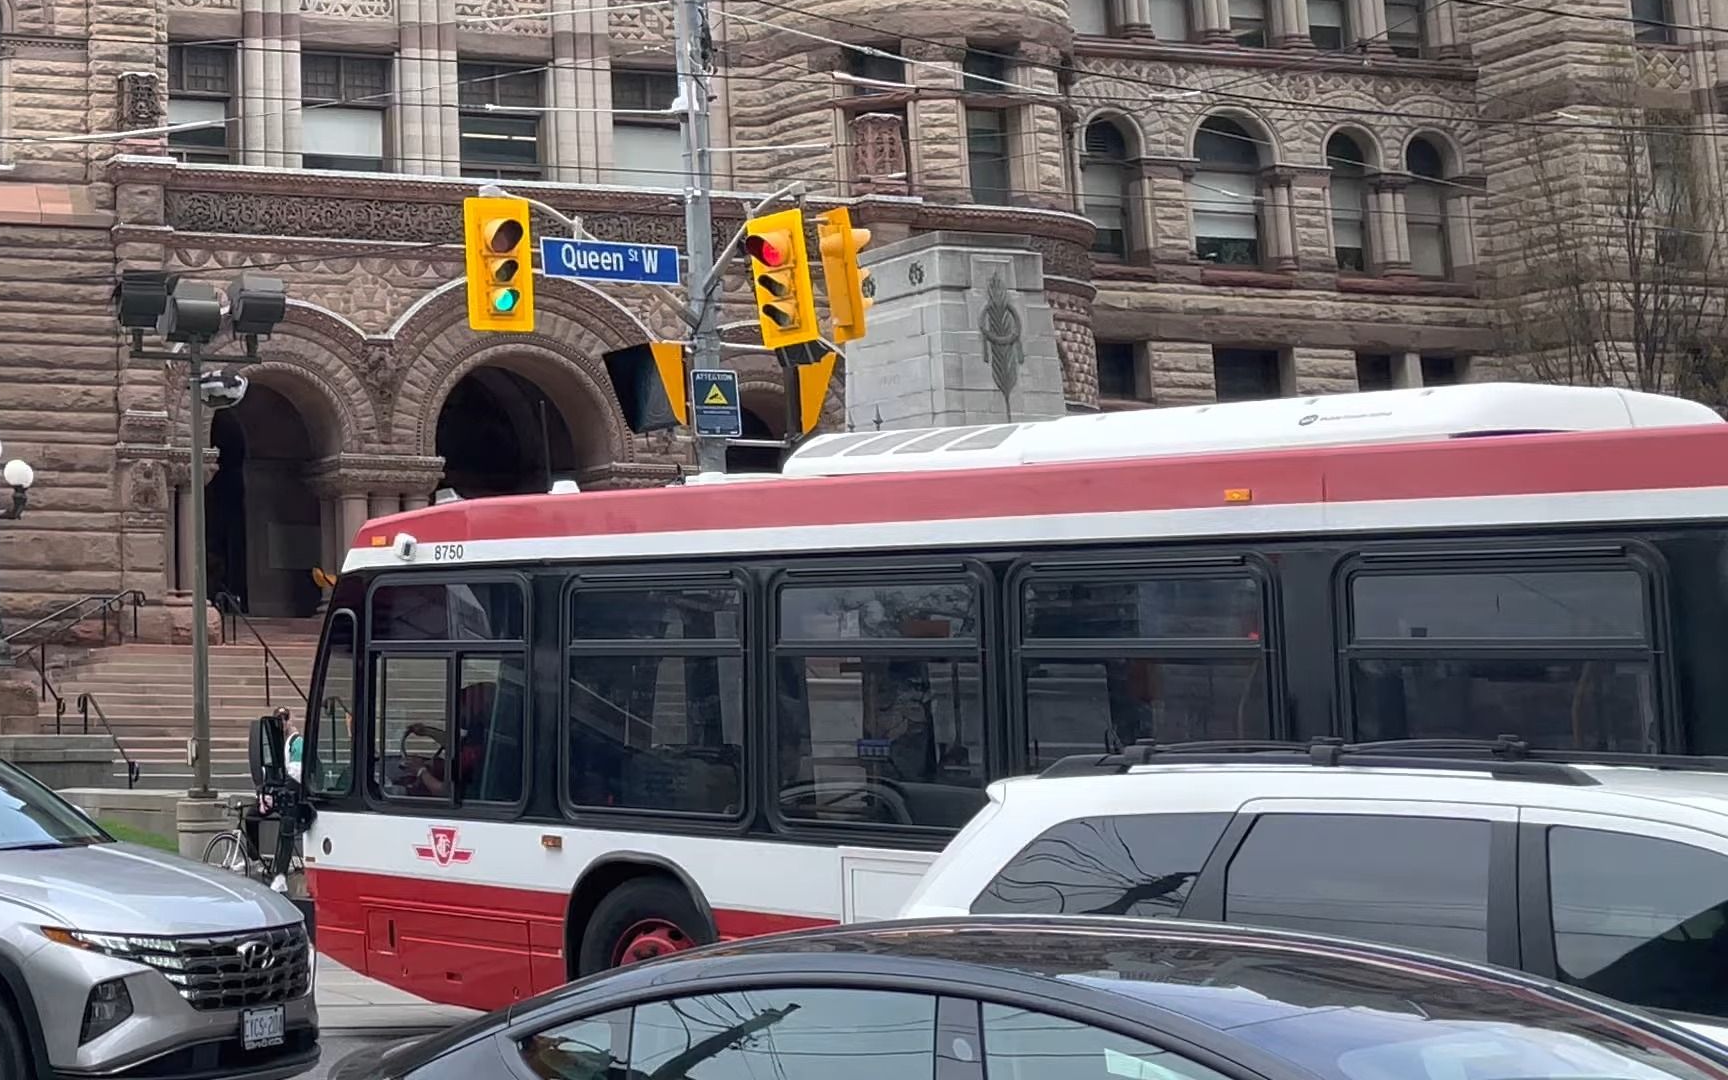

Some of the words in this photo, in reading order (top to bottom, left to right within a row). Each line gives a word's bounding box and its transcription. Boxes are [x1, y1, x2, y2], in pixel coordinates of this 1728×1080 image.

[561, 243, 624, 272] Queen
[628, 248, 639, 262] St
[642, 249, 659, 274] W
[434, 544, 464, 560] 8750
